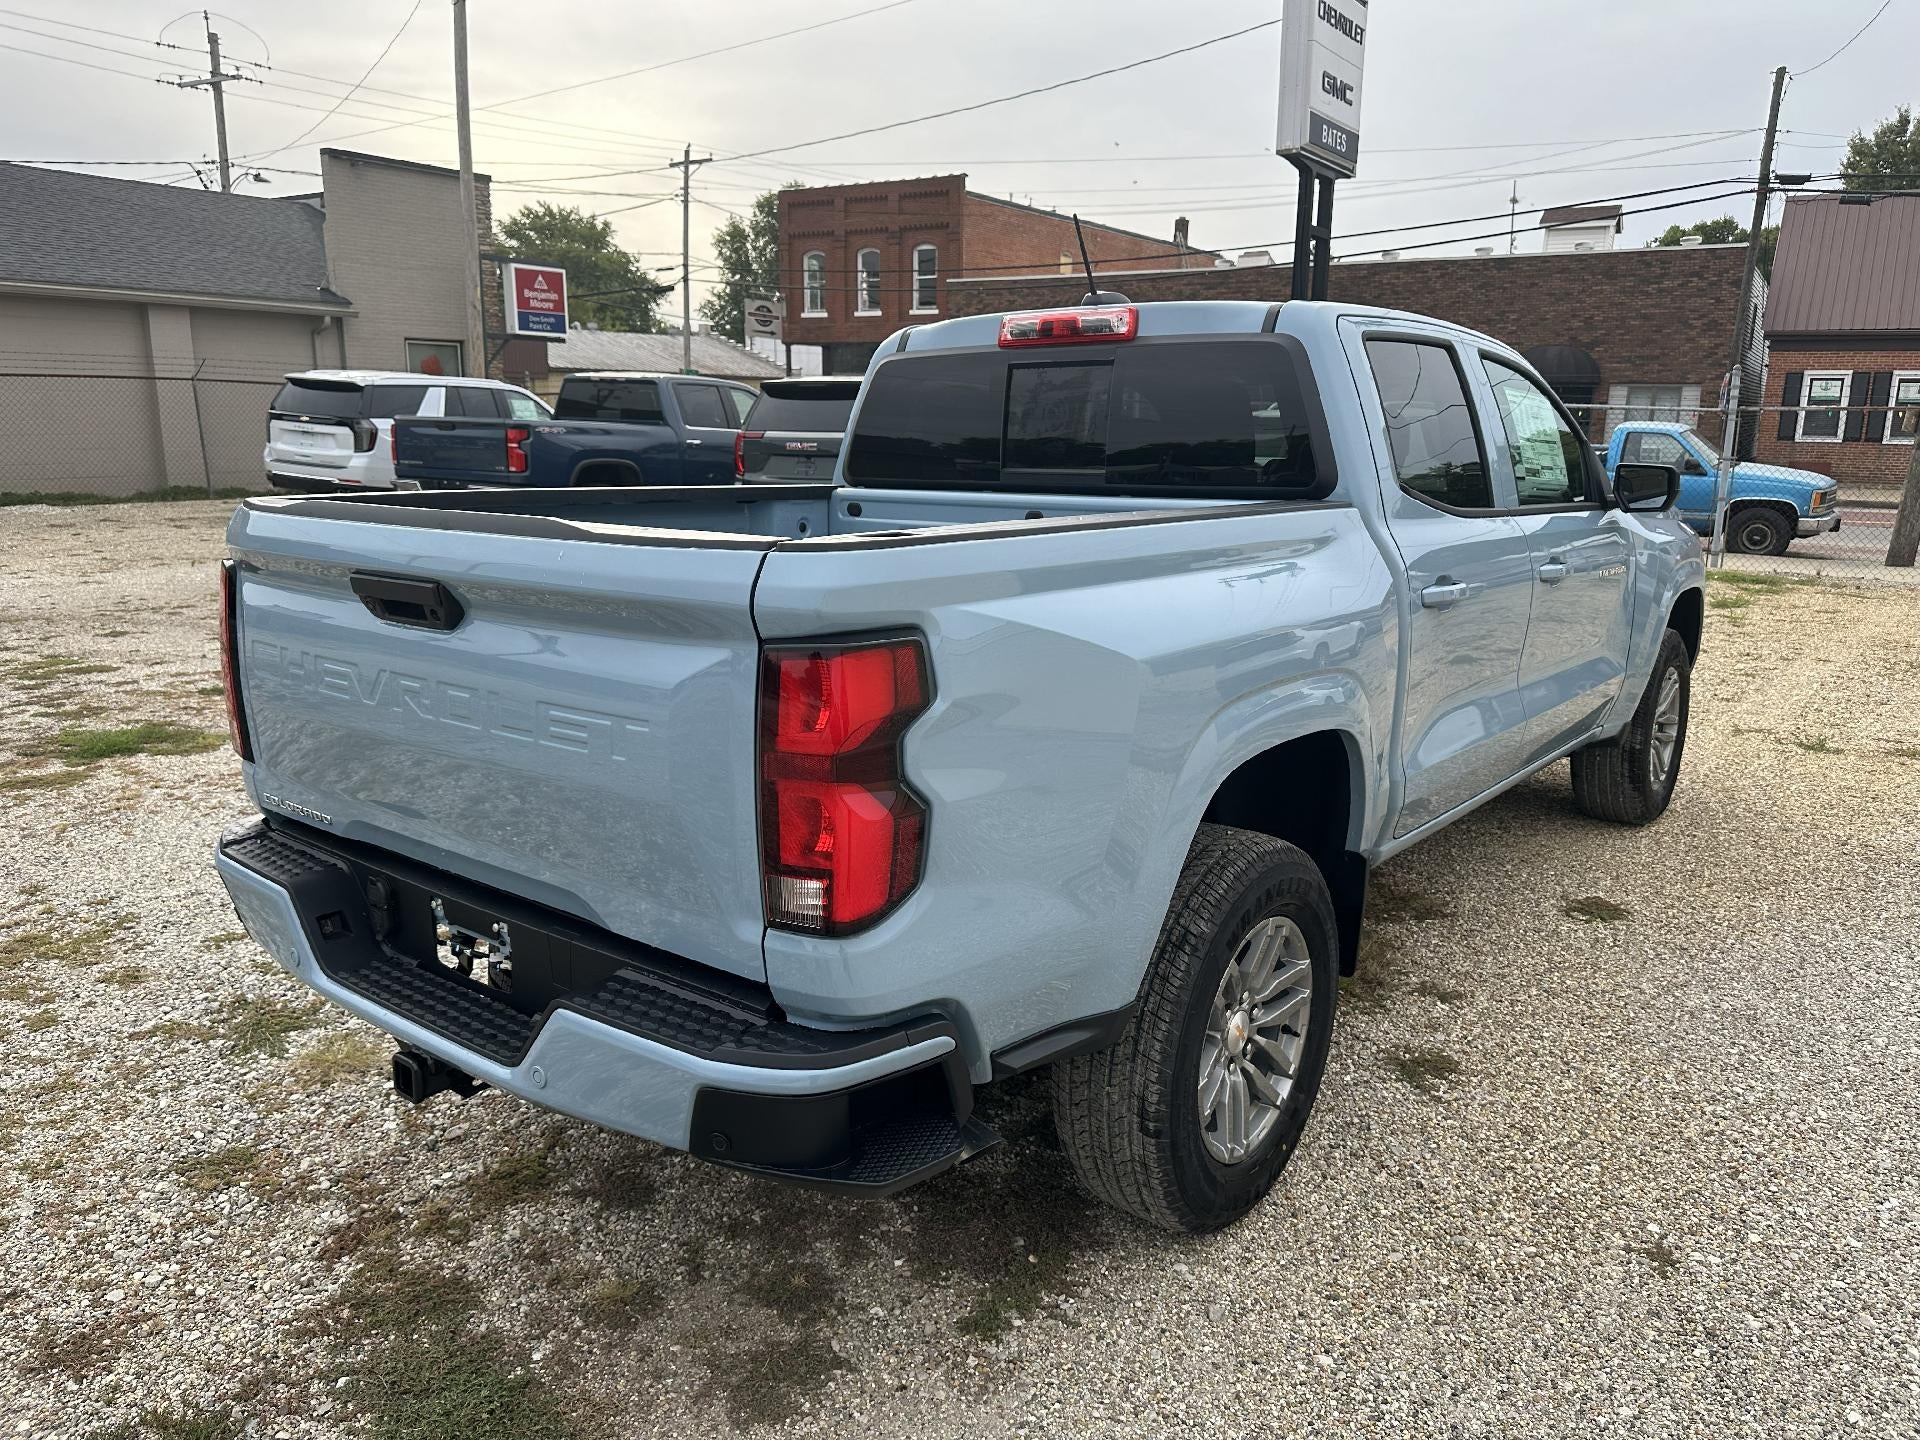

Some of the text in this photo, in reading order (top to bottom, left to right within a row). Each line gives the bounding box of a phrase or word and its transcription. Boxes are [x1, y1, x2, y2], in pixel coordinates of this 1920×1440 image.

[1318, 0, 1366, 45] CHEVROLET
[1322, 70, 1354, 106] GMC
[1321, 124, 1347, 153] BATES
[523, 288, 559, 300] Benjamin
[529, 299, 554, 310] Moore
[251, 639, 651, 762] CHEVROLET
[263, 792, 333, 826] COLORADO
